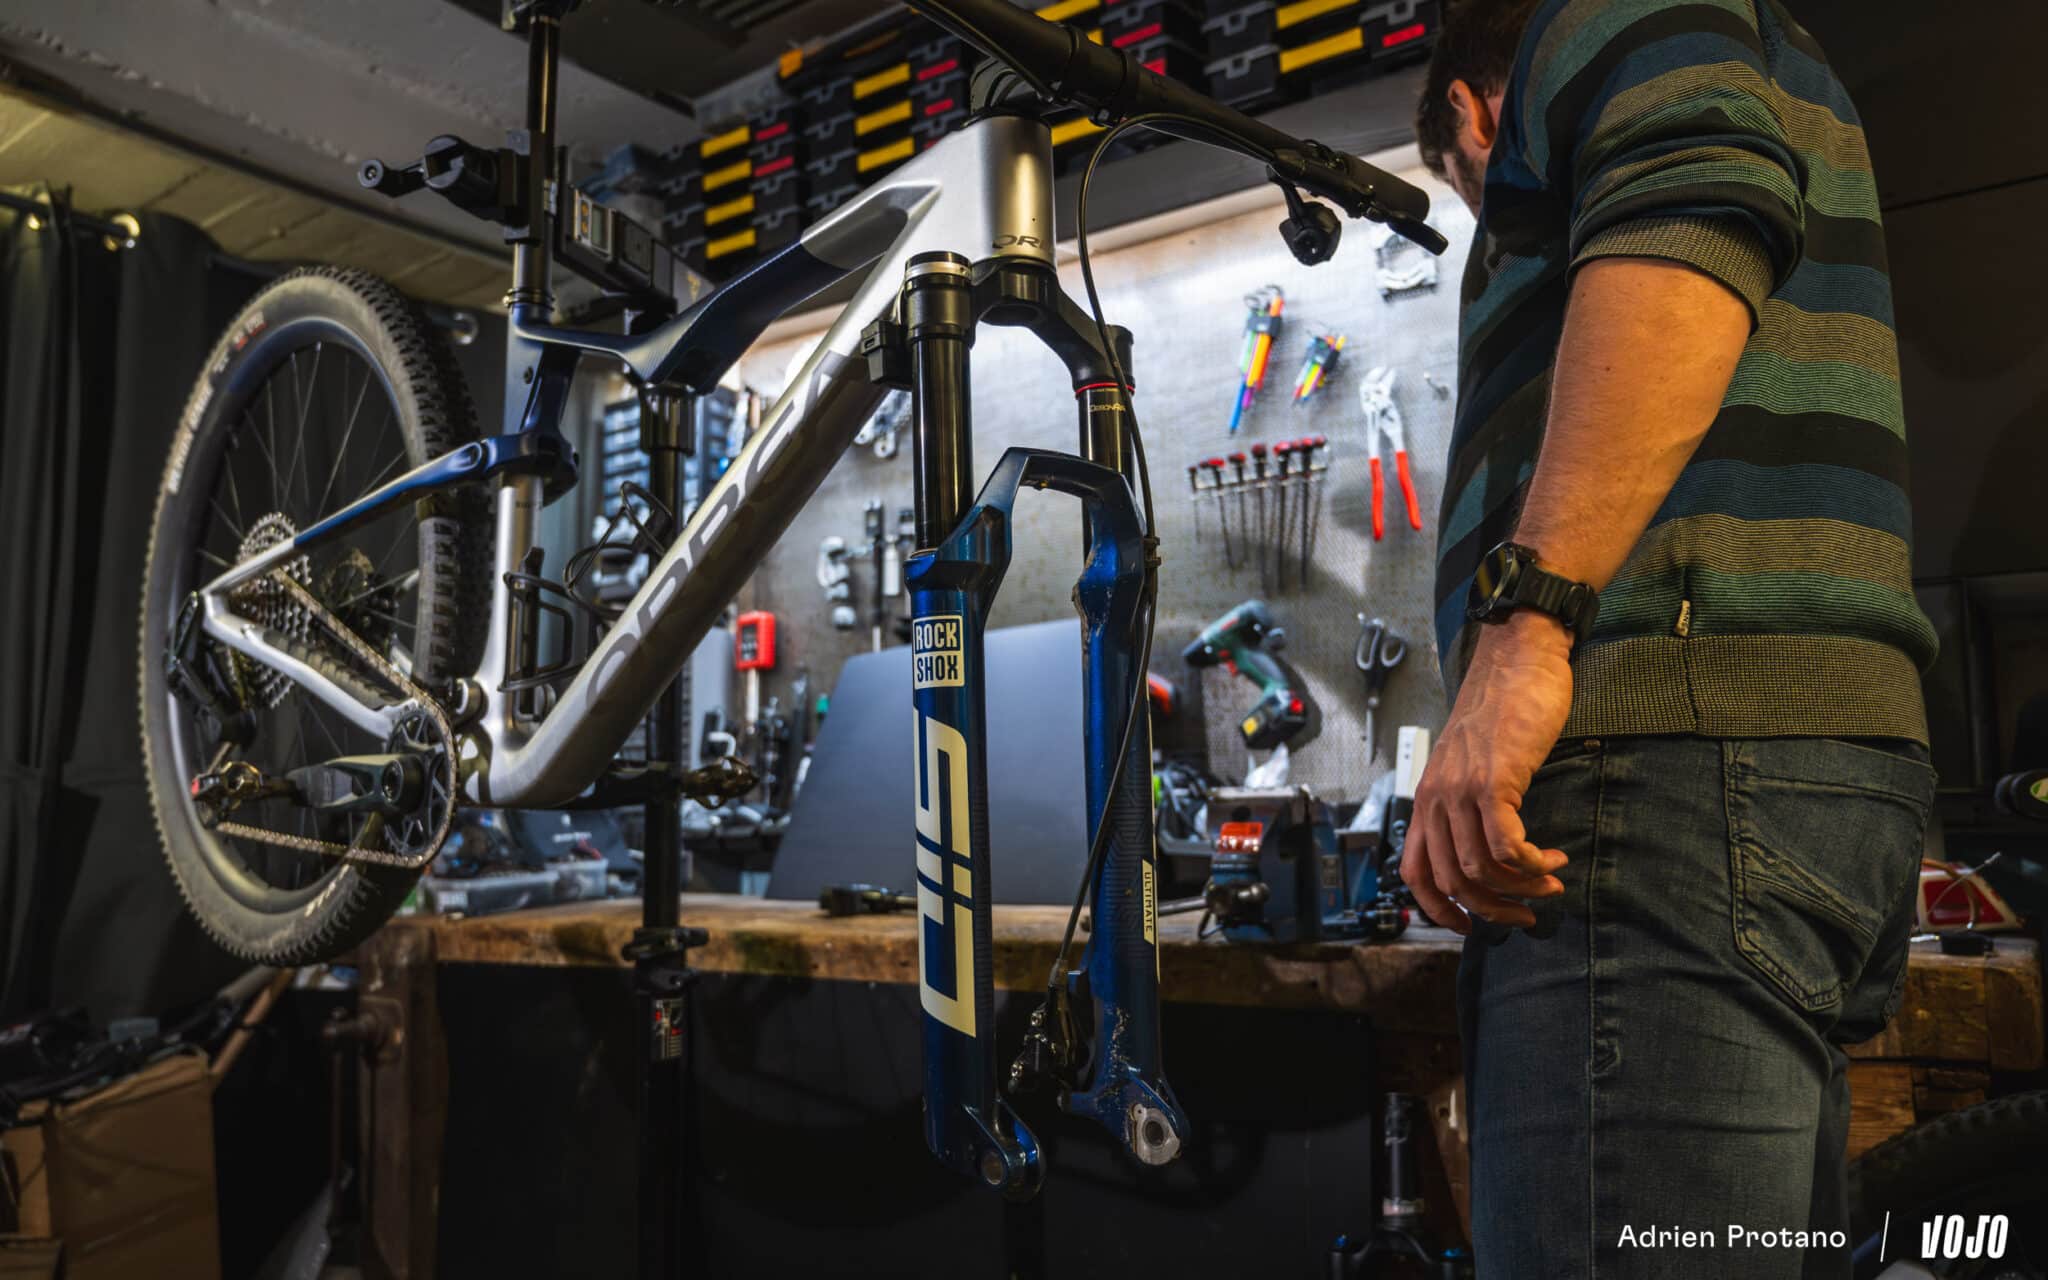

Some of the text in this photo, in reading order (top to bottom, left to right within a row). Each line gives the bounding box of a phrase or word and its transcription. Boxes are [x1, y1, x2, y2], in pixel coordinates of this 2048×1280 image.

[915, 622, 957, 651] ROCK
[917, 655, 958, 682] SHOX
[913, 707, 976, 1037] SID
[1144, 871, 1153, 933] ULTIMATE
